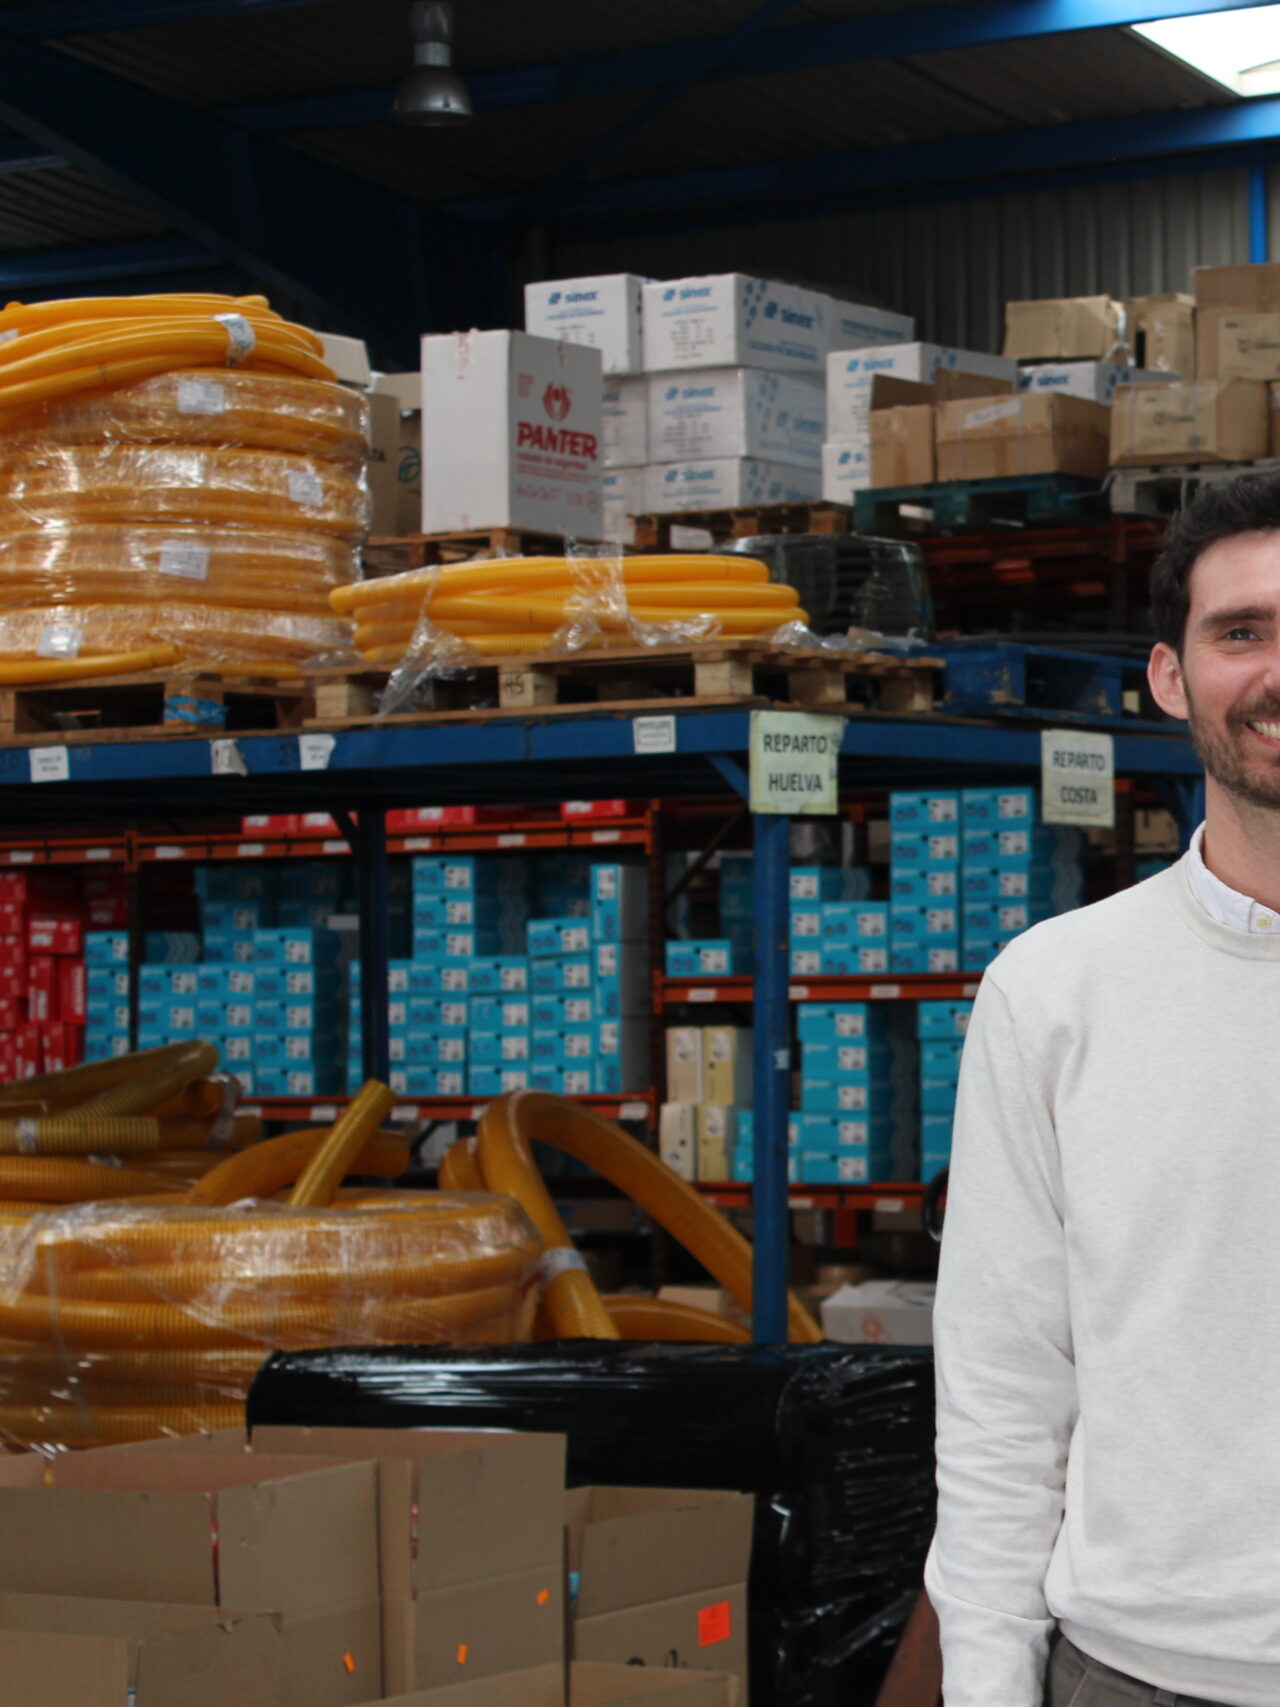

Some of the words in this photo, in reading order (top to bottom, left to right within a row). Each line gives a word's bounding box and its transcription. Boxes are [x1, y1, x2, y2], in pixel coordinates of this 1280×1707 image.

[517, 421, 598, 461] PANTER
[763, 733, 827, 754] REPARTO
[1053, 750, 1105, 771] REPARTO
[768, 773, 823, 792] HUELVA
[1060, 785, 1097, 805] COSTA
